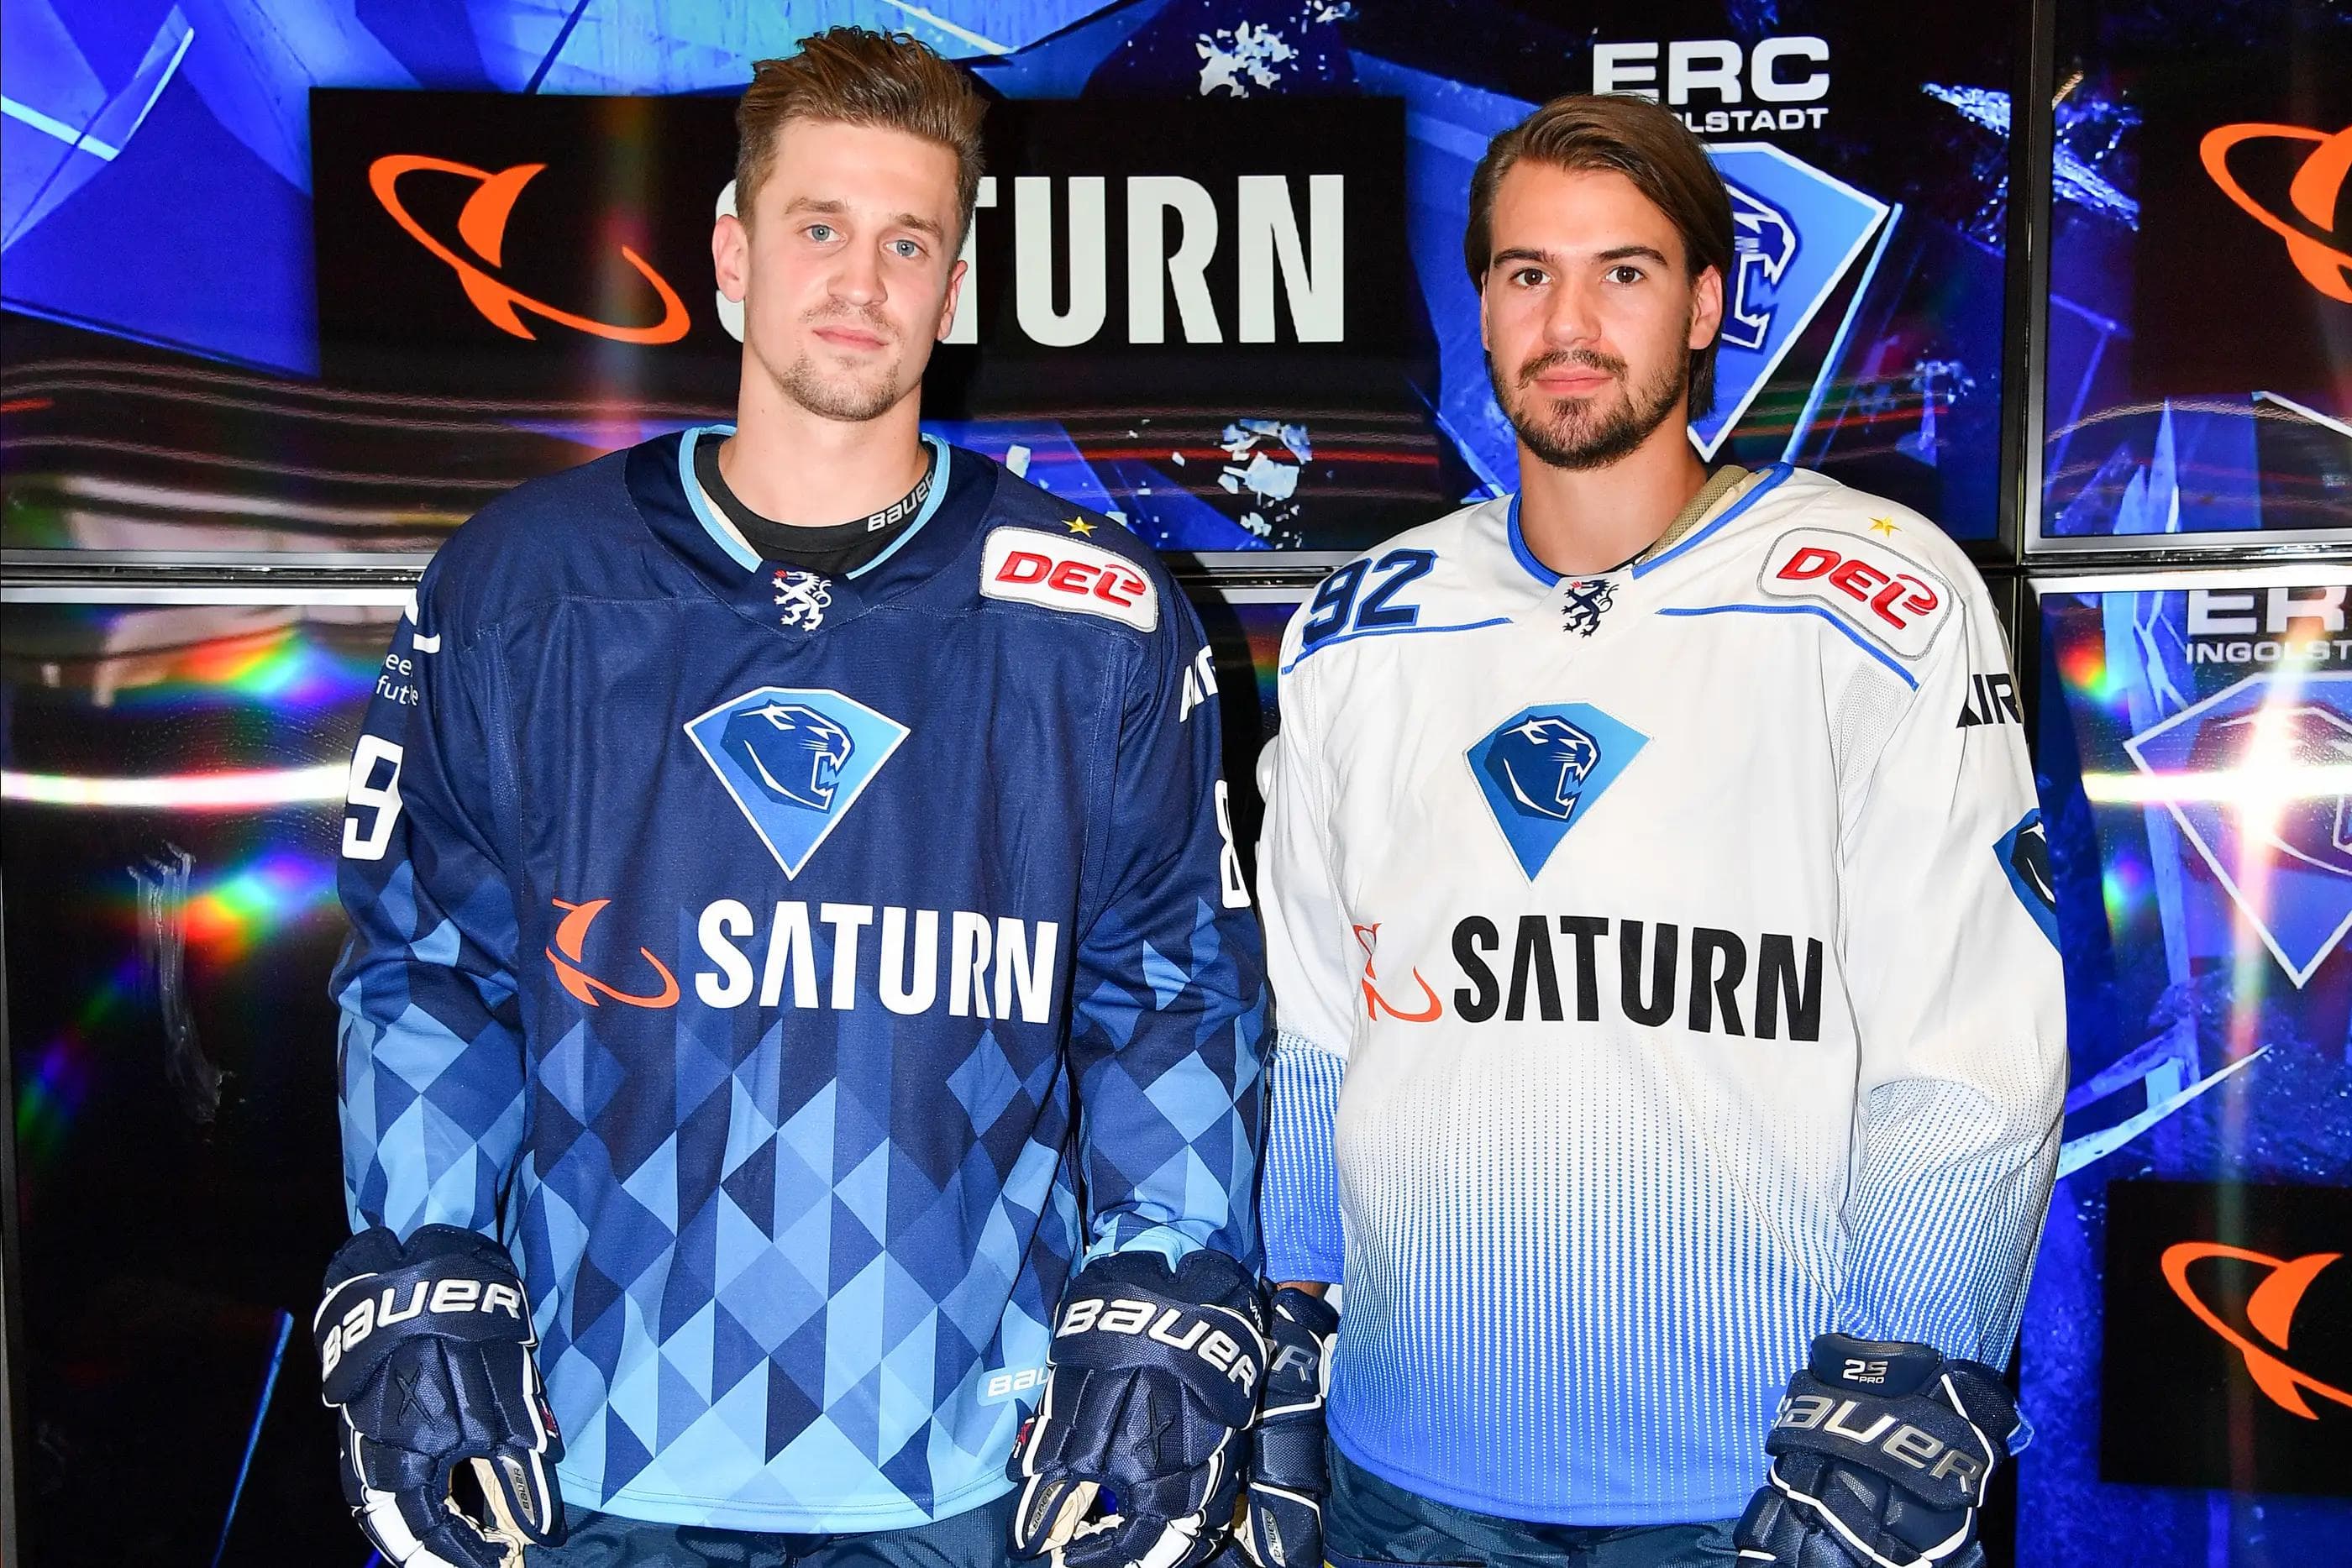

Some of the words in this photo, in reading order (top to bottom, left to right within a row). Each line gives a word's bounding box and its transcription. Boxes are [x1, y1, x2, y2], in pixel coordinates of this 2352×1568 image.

[1593, 36, 1830, 106] ERC
[1672, 108, 1829, 133] LSTADT
[714, 176, 1345, 348] TURN
[1302, 548, 1439, 647] 92
[696, 899, 1058, 1024] SATURN
[1452, 915, 1822, 1041] SATURN
[1859, 1376, 1884, 1384] PRO
